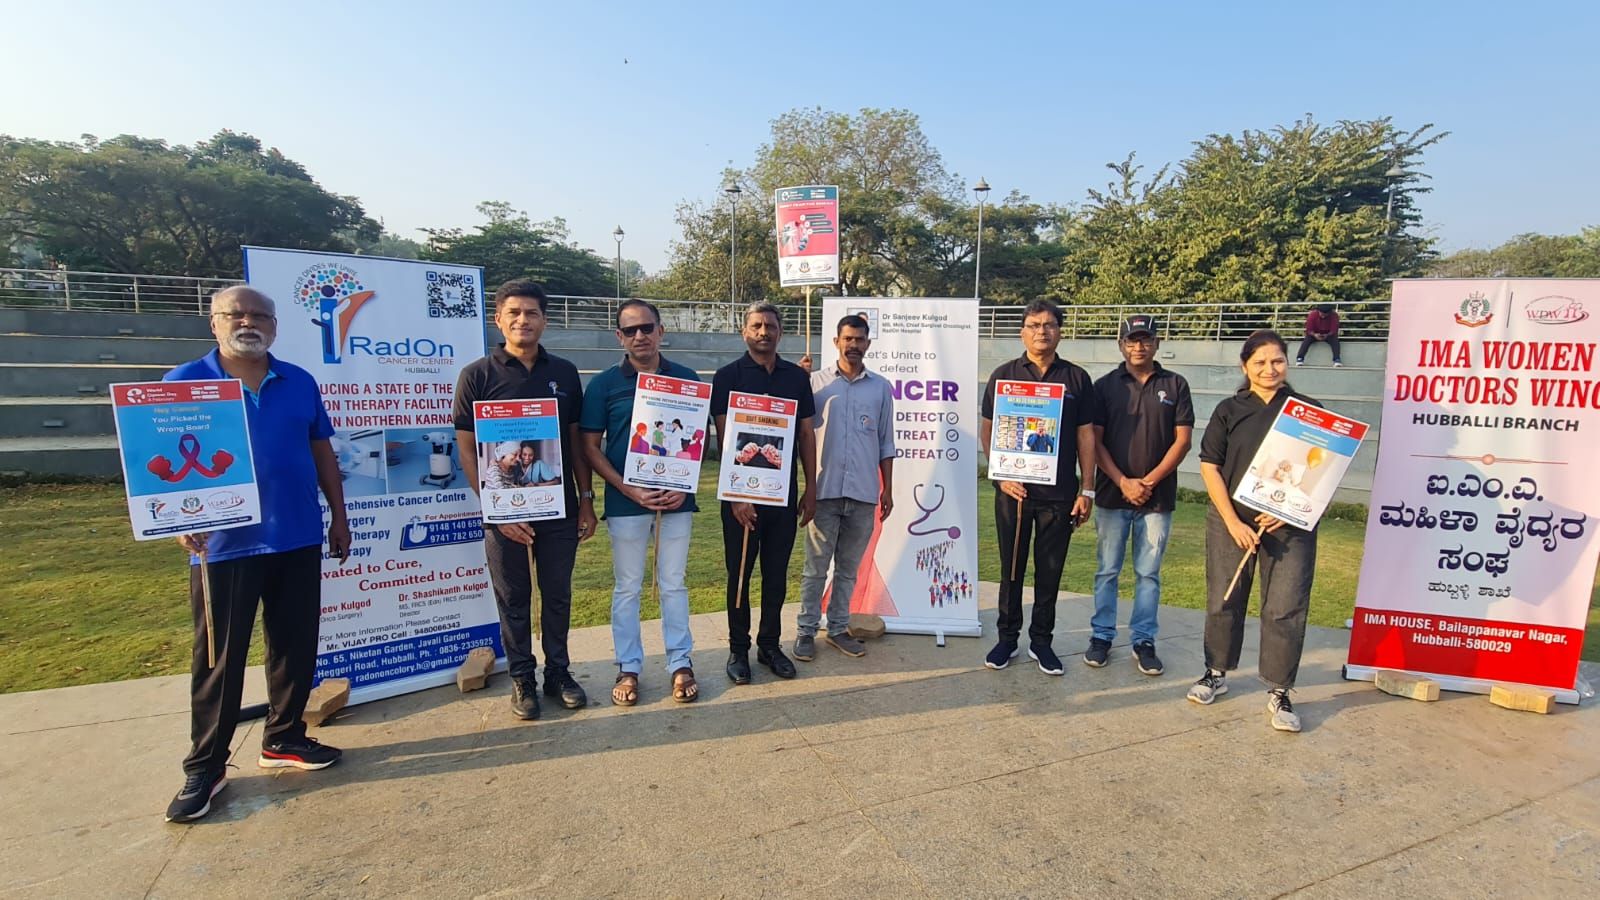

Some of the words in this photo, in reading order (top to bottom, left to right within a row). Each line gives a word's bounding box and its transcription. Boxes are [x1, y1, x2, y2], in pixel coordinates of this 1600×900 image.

[349, 336, 454, 357] RadOn
[378, 357, 419, 365] CANCER
[421, 357, 455, 366] CENTRE
[863, 351, 888, 360] et's
[891, 351, 921, 360] Unite
[925, 351, 936, 360] to
[1418, 340, 1472, 368] IMA
[1482, 340, 1596, 371] WOMEN
[880, 364, 918, 373] defeat
[320, 383, 359, 395] UCING
[363, 383, 372, 394] A
[375, 383, 410, 394] STATE
[414, 383, 429, 394] OF
[432, 383, 453, 394] THE
[889, 379, 960, 402] NCER
[1394, 374, 1519, 405] DOCTORS
[322, 399, 341, 411] ON
[345, 399, 400, 411] THERAPY
[404, 398, 453, 410] FACILITY
[152, 416, 169, 424] You
[170, 414, 198, 423] Picked
[346, 415, 411, 427] NORTHERN
[416, 414, 453, 425] KARNA
[896, 411, 945, 422] DETECT
[1412, 412, 1499, 428] HUBBALLI
[1502, 416, 1580, 432] BRANCH
[156, 425, 184, 433] Wrong
[185, 423, 210, 431] Board
[896, 429, 936, 441] TREAT
[895, 448, 944, 459] DEFEAT
[1426, 473, 1544, 502] ಐ.ಎಂ.ಎ.
[398, 494, 433, 506] Cancer
[435, 492, 467, 504] Centre
[347, 515, 376, 527] rgery
[429, 522, 450, 532] 9148
[452, 521, 466, 531] 140
[467, 519, 482, 530] 659
[1379, 499, 1479, 532] ಮಹಿಳಾ
[1495, 506, 1587, 552] ವೈದ್ಯರ
[354, 528, 391, 542] herapy
[430, 533, 450, 544] 9741
[452, 532, 467, 541] 782
[468, 530, 483, 541] 650
[367, 564, 381, 574] to
[385, 559, 422, 571] Cure,
[1437, 543, 1511, 578] ಸಂಘ
[359, 571, 435, 591] Committed
[439, 570, 452, 580] to
[398, 593, 409, 602] Dr.
[412, 585, 461, 600] Shashikanth
[463, 580, 489, 593] Kulgod
[1478, 586, 1512, 598] ಶಾಖೆ
[341, 598, 371, 612] Kulgod
[319, 634, 334, 643] For
[335, 631, 356, 640] More
[359, 622, 403, 635] Information
[405, 617, 431, 628] Please
[432, 612, 461, 623] Contact
[1364, 613, 1386, 625] IMA
[1390, 615, 1434, 631] HOUSE,
[1438, 620, 1525, 640] Bailappanavar
[1529, 629, 1568, 645] Nagar,
[326, 643, 340, 651] Mr.
[342, 638, 368, 648] VIJAY
[370, 634, 389, 643] PRO
[390, 631, 407, 640] Cell
[419, 650, 432, 658] Ph.
[439, 637, 493, 655] 0836-2335925
[1413, 632, 1512, 653] Hubballi-580029
[316, 657, 331, 667] No.
[350, 648, 382, 661] Niketan
[418, 636, 442, 647] Javali
[443, 631, 470, 643] Garden
